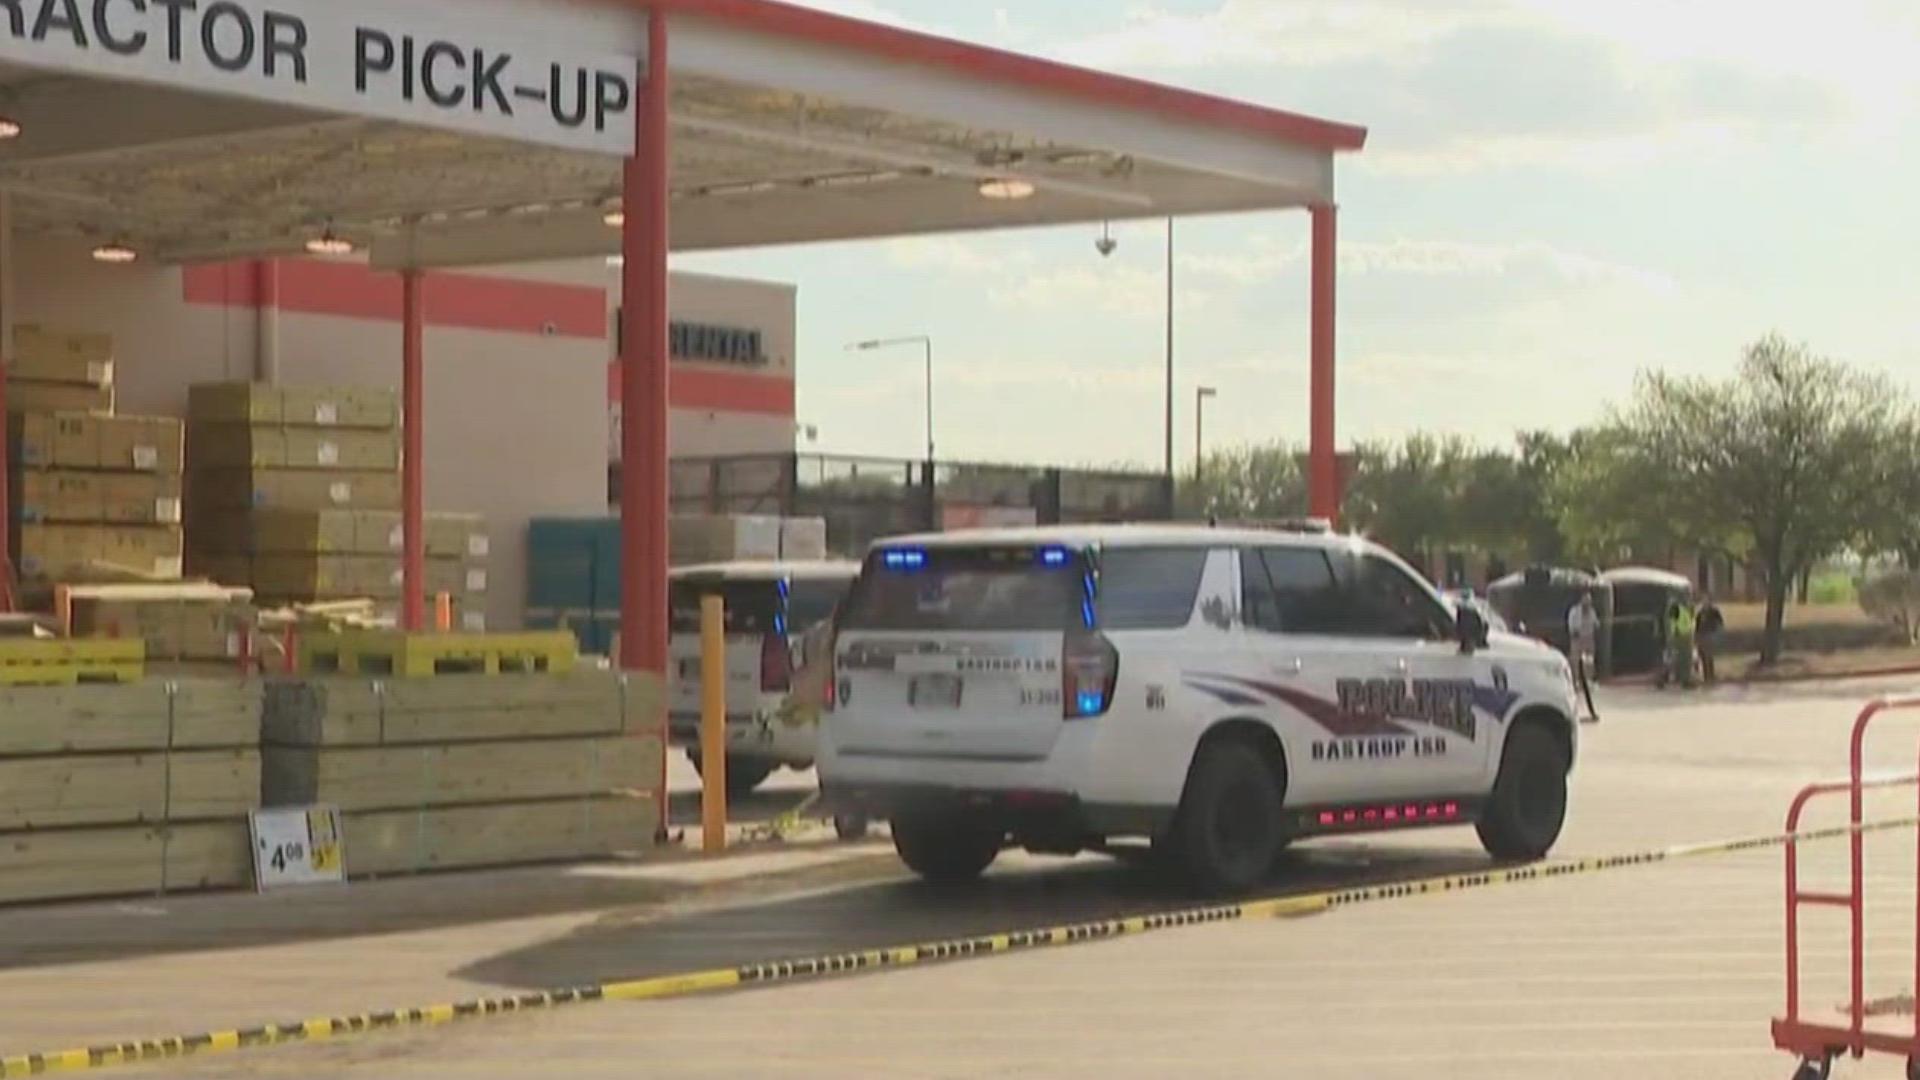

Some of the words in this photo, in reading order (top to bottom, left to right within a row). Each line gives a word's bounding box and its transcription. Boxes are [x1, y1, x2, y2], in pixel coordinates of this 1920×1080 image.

[354, 26, 630, 132] PICK-UP
[1335, 678, 1477, 743] POLICE
[1311, 738, 1406, 761] BASTROP
[1414, 736, 1447, 757] ISD
